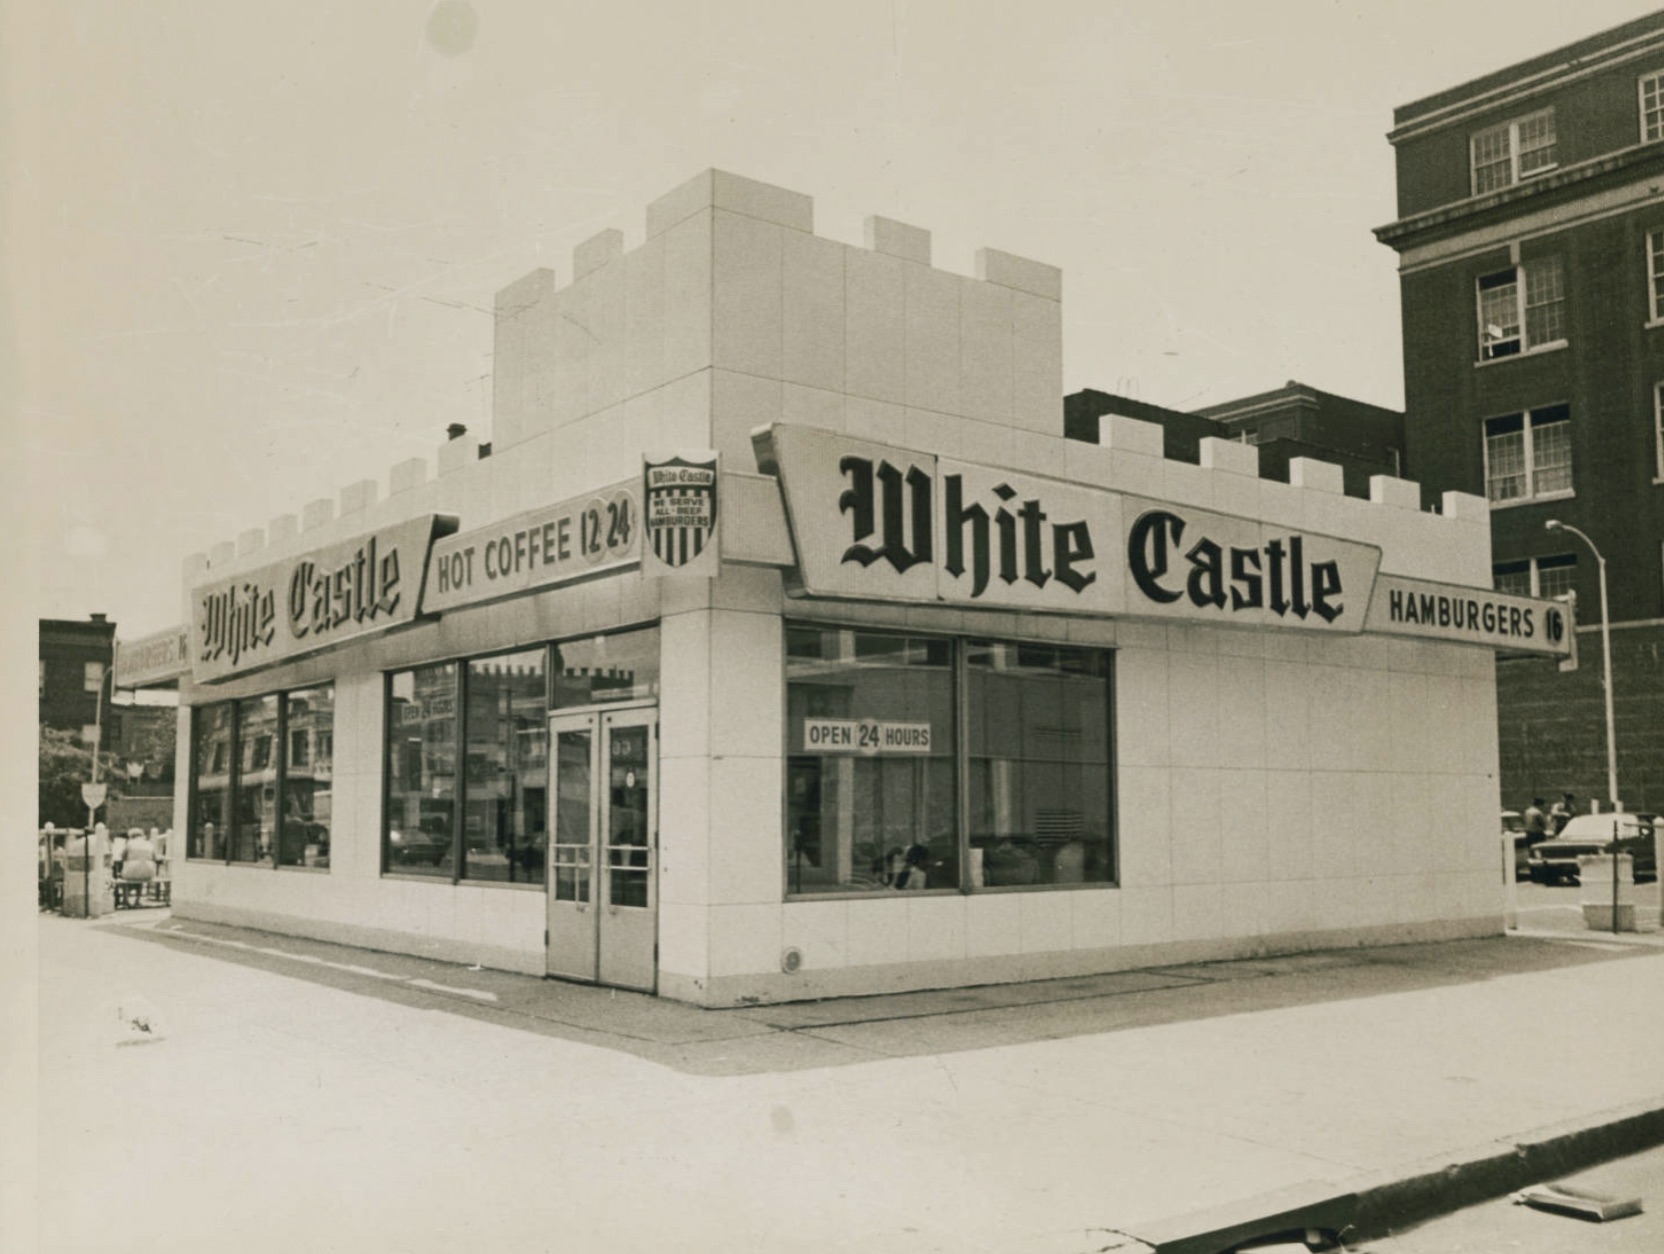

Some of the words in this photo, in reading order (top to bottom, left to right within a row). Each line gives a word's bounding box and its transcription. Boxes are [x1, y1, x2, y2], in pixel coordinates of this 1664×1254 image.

[653, 470, 677, 484] White
[679, 469, 711, 483] Castle
[670, 498, 703, 506] SERVE
[438, 546, 475, 594] HOT
[485, 516, 571, 580] COFFEE
[581, 508, 600, 556] 12
[607, 499, 630, 547] 24
[839, 455, 1096, 598] White
[1128, 508, 1345, 624] Castle
[200, 582, 275, 667] White
[287, 535, 401, 640] Castle
[1389, 589, 1535, 637] HAMBURGERS
[1546, 608, 1564, 642] 16
[810, 726, 851, 743] OPEN
[858, 725, 880, 746] 24
[886, 729, 928, 745] HOURS
